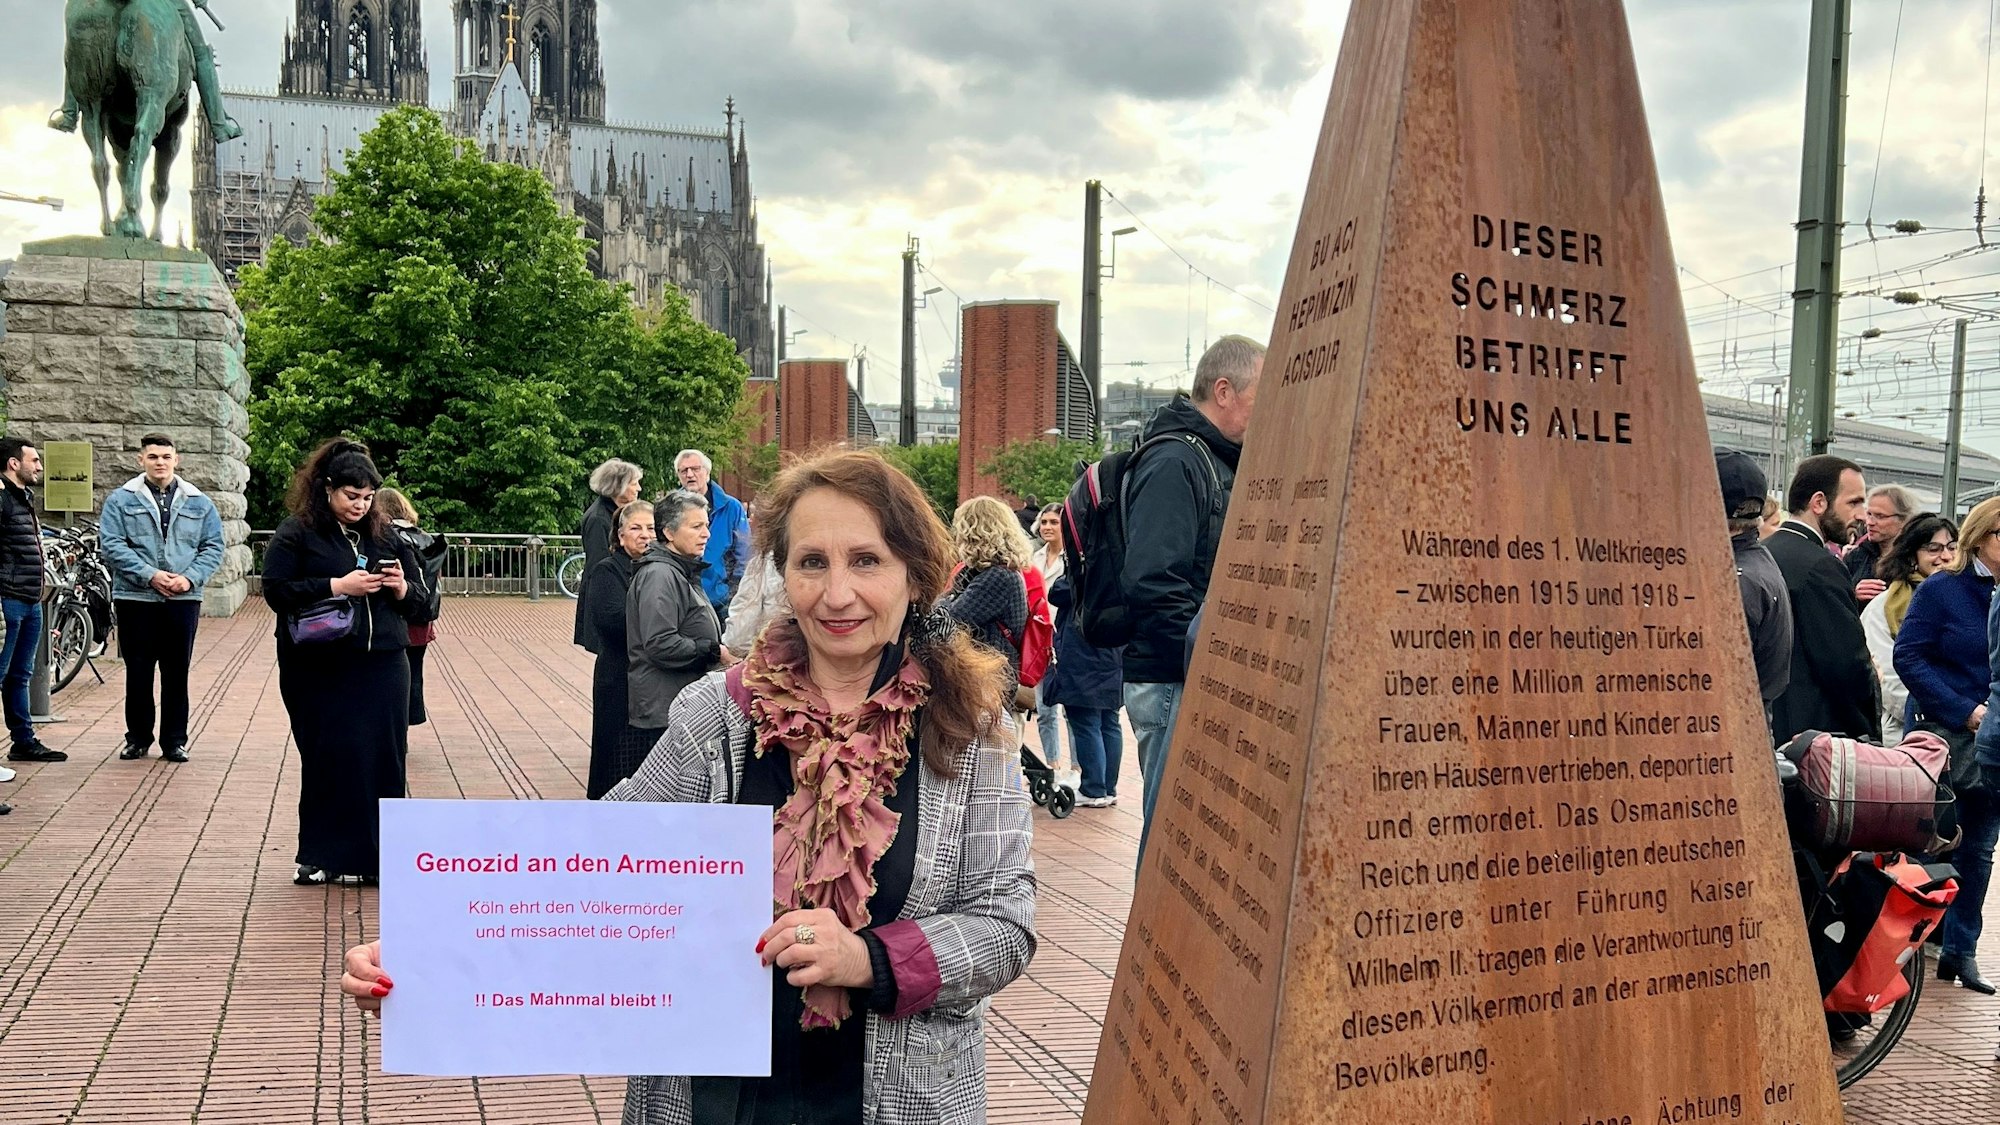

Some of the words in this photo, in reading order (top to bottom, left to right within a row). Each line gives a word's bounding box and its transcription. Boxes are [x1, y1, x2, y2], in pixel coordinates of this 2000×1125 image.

[1310, 233, 1330, 271] BU
[1331, 216, 1358, 261] ACI
[1473, 214, 1604, 267] DIESER
[1289, 263, 1358, 333] HEPİMİZİN
[1451, 272, 1627, 328] SCHMERZ
[1281, 339, 1340, 387] ACISIDIR
[1456, 335, 1627, 386] BETRIFFT
[1455, 397, 1529, 437] UNS
[1547, 406, 1632, 445] ALLE
[1402, 529, 1500, 560] Während
[1507, 534, 1544, 561] des
[1551, 539, 1569, 561] 1.
[1575, 537, 1687, 570] Weltkrieges
[1416, 578, 1519, 604] zwischen
[1530, 580, 1577, 606] 1915
[1586, 582, 1623, 606] und
[1631, 584, 1678, 607] 1918
[1390, 624, 1475, 650] wurden
[1483, 627, 1500, 648] in
[1508, 625, 1543, 649] der
[1550, 625, 1637, 655] heutigen
[1642, 624, 1703, 649] Türkei
[1384, 671, 1438, 697] über
[1451, 673, 1499, 696] eine
[1512, 669, 1583, 694] Million
[1596, 668, 1712, 693] armenische
[1379, 717, 1468, 745] Frauen,
[1477, 714, 1560, 742] Männer
[1568, 713, 1607, 738] und
[1614, 711, 1680, 736] Kinder
[1687, 713, 1721, 734] aus
[1372, 765, 1427, 792] ihren
[1434, 761, 1524, 790] Häusern
[1526, 757, 1634, 785] vertrieben,
[1639, 751, 1734, 783] deportiert
[1366, 813, 1413, 841] und
[1427, 805, 1544, 838] ermordet.
[1556, 801, 1599, 828] Das
[1610, 793, 1738, 825] Osmanische
[416, 852, 518, 873] Genozid
[527, 856, 556, 873] an
[566, 853, 610, 874] den
[616, 853, 745, 876] Armeniern
[1361, 857, 1430, 890] Reich
[1436, 853, 1480, 883] und
[1485, 849, 1521, 880] die
[1526, 846, 1639, 878] beteiligten
[1644, 834, 1746, 866] deutschen
[468, 900, 504, 915] Köln
[509, 900, 540, 914] ehrt
[545, 901, 574, 914] den
[580, 900, 684, 916] Völkermörder
[1354, 907, 1464, 939] Offiziere
[1490, 897, 1552, 926] unter
[1576, 885, 1668, 921] Führung
[1690, 878, 1755, 905] Kaiser
[475, 925, 505, 938] und
[511, 924, 596, 938] missachtet
[600, 925, 623, 939] die
[627, 925, 675, 942] Opfer!
[1347, 955, 1441, 990] Wilhelm
[1450, 951, 1469, 977] II.
[1477, 942, 1546, 978] tragen
[1554, 936, 1587, 965] die
[1592, 919, 1735, 959] Verantwortung
[1738, 916, 1764, 942] für
[475, 993, 486, 1007] !!
[492, 993, 524, 1007] Das
[529, 993, 605, 1007] Mahnmal
[610, 993, 656, 1007] bleibt
[661, 993, 673, 1007] !!
[1341, 1007, 1425, 1040] diesen
[1432, 983, 1565, 1027] Völkermord
[1572, 984, 1598, 1006] an
[1604, 975, 1640, 1005] der
[1646, 958, 1771, 997] armenischen
[1335, 1046, 1495, 1091] Bevölkerung.
[1657, 1093, 1741, 1125] Ächtung
[1764, 1080, 1795, 1105] der
